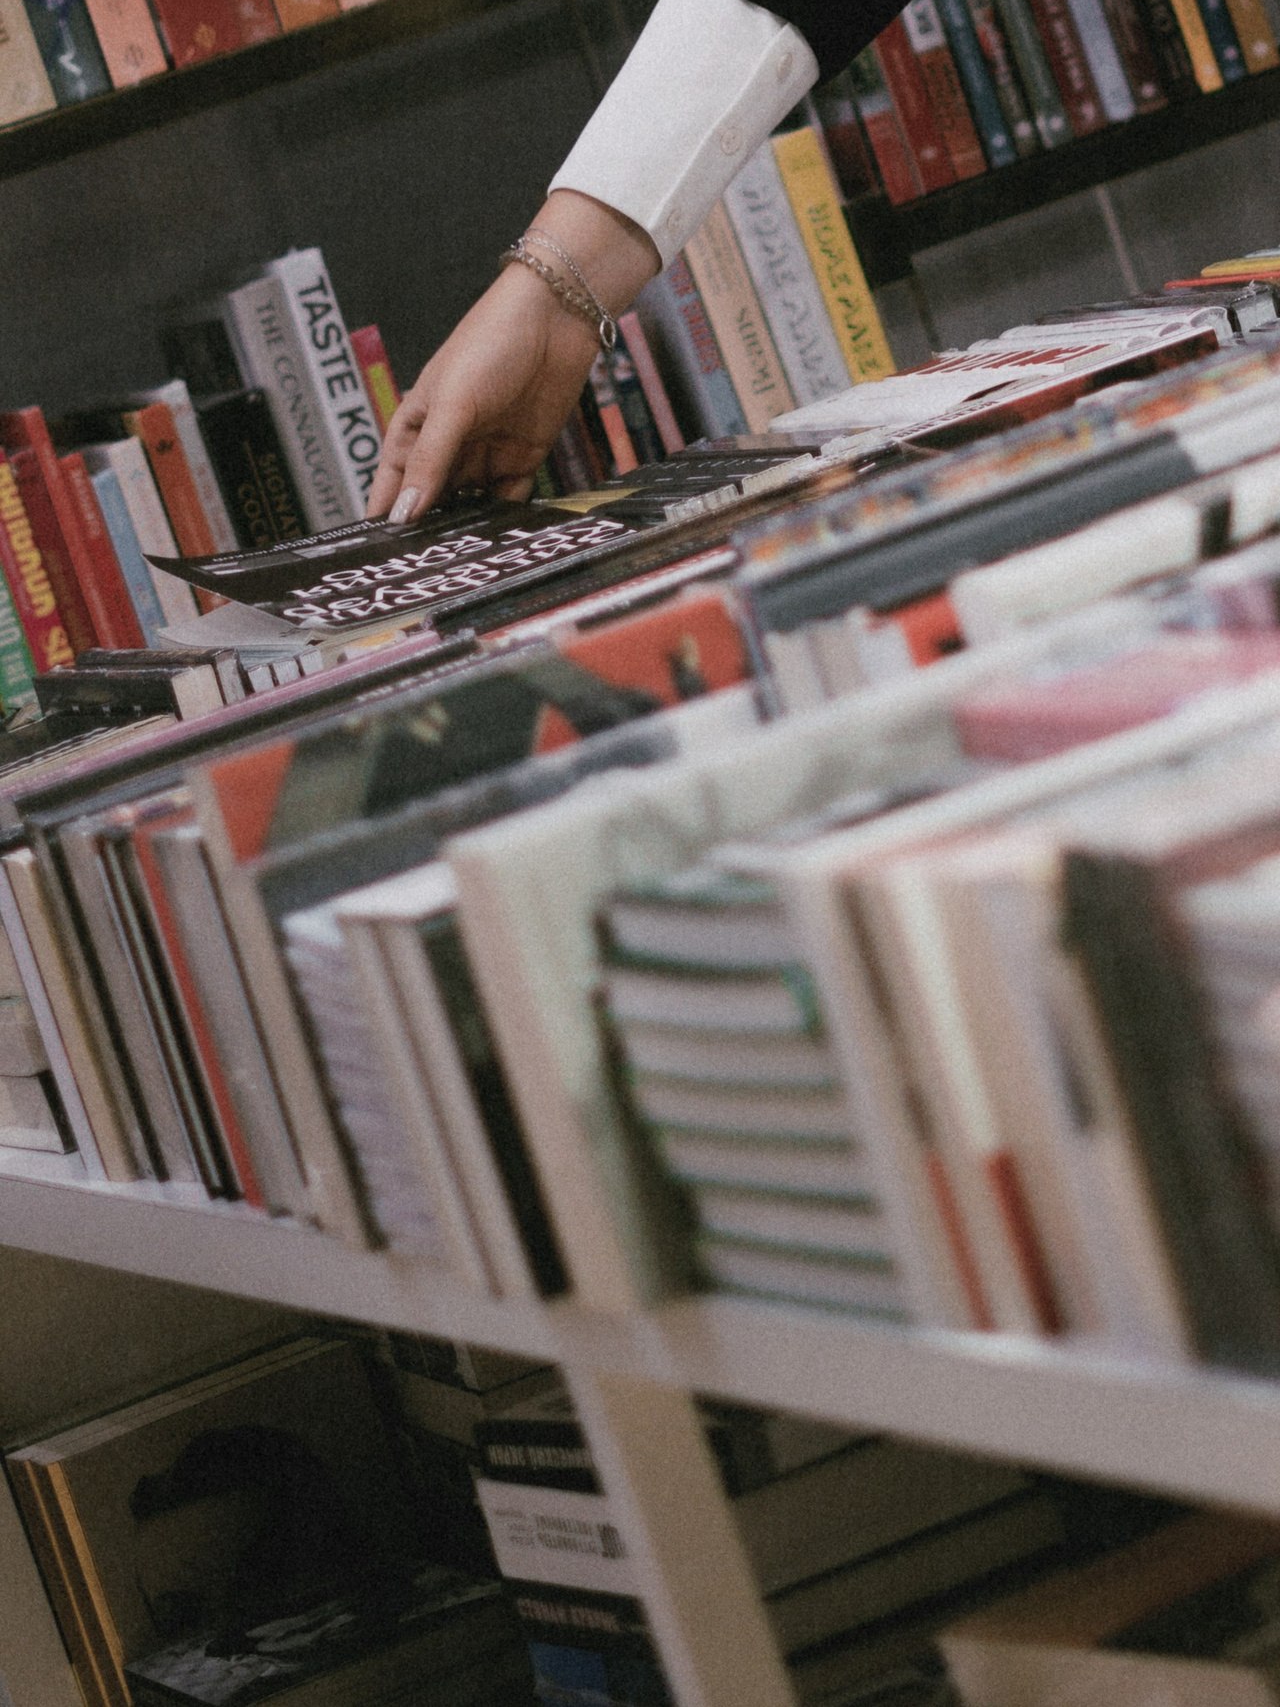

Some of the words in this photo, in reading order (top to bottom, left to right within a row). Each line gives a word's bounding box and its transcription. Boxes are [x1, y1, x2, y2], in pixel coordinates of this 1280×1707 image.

[292, 274, 360, 400] TASTE
[253, 298, 286, 348] THE
[271, 352, 343, 521] CONNAUGHT
[283, 520, 627, 619] Кракауэр
[287, 528, 552, 598] Теория
[322, 535, 481, 583] кино
